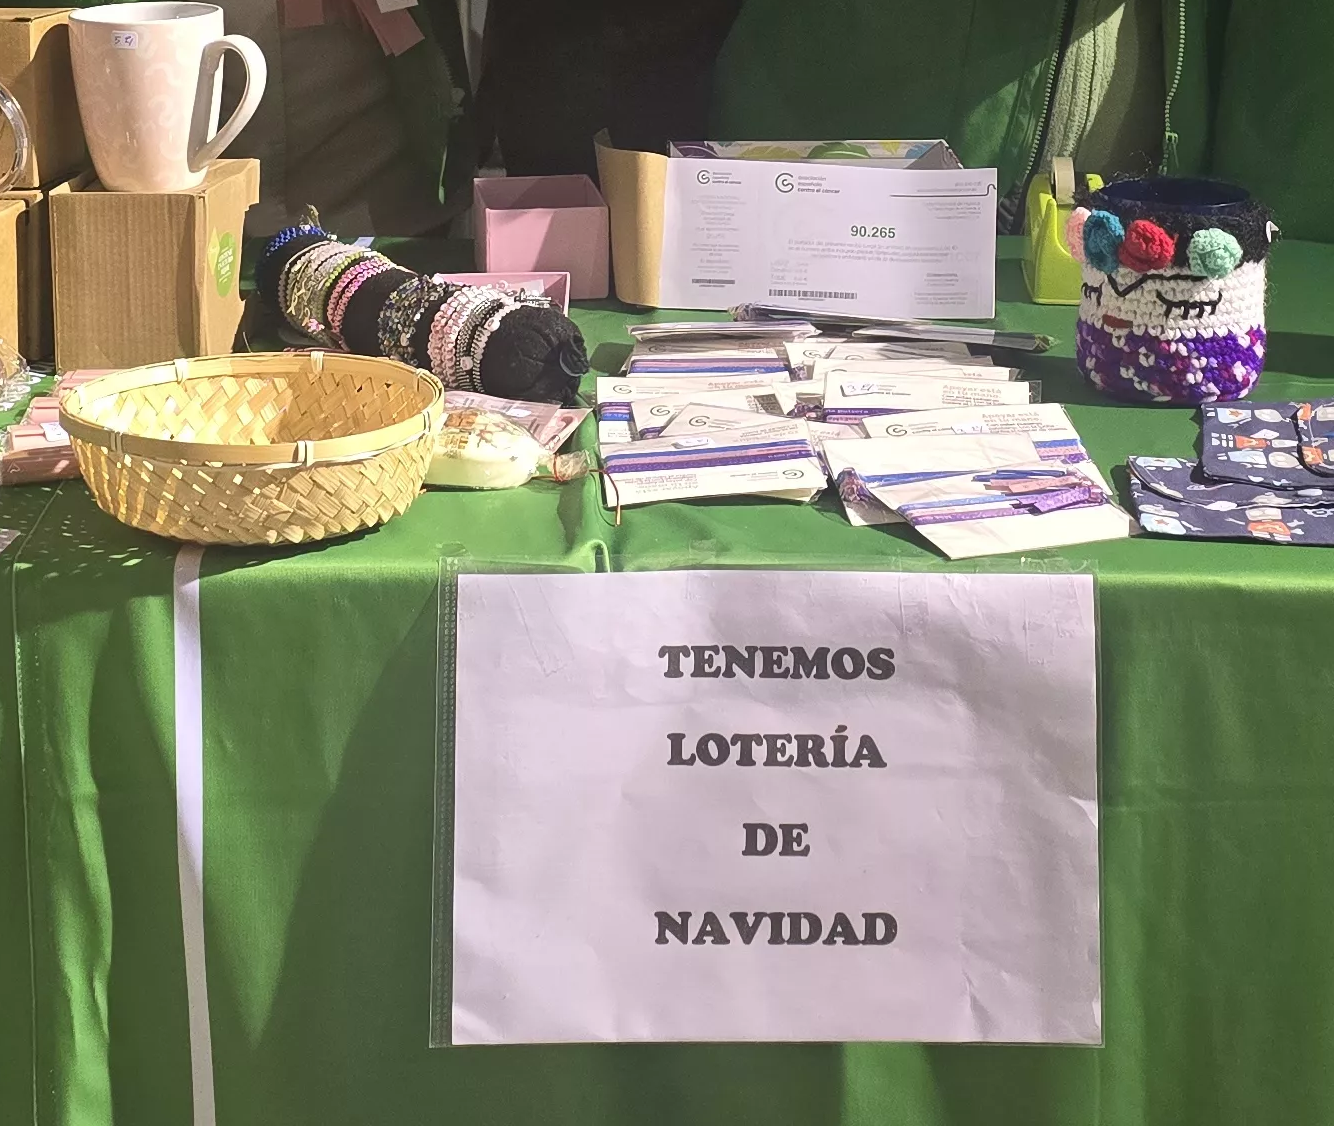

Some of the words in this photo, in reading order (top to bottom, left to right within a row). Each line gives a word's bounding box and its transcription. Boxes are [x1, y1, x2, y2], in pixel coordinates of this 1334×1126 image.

[850, 225, 896, 239] 90.265
[658, 645, 896, 681] TENEMOS
[666, 725, 887, 768] LOTERÍA
[742, 822, 810, 858] DE
[654, 911, 898, 947] NAVIDAD
